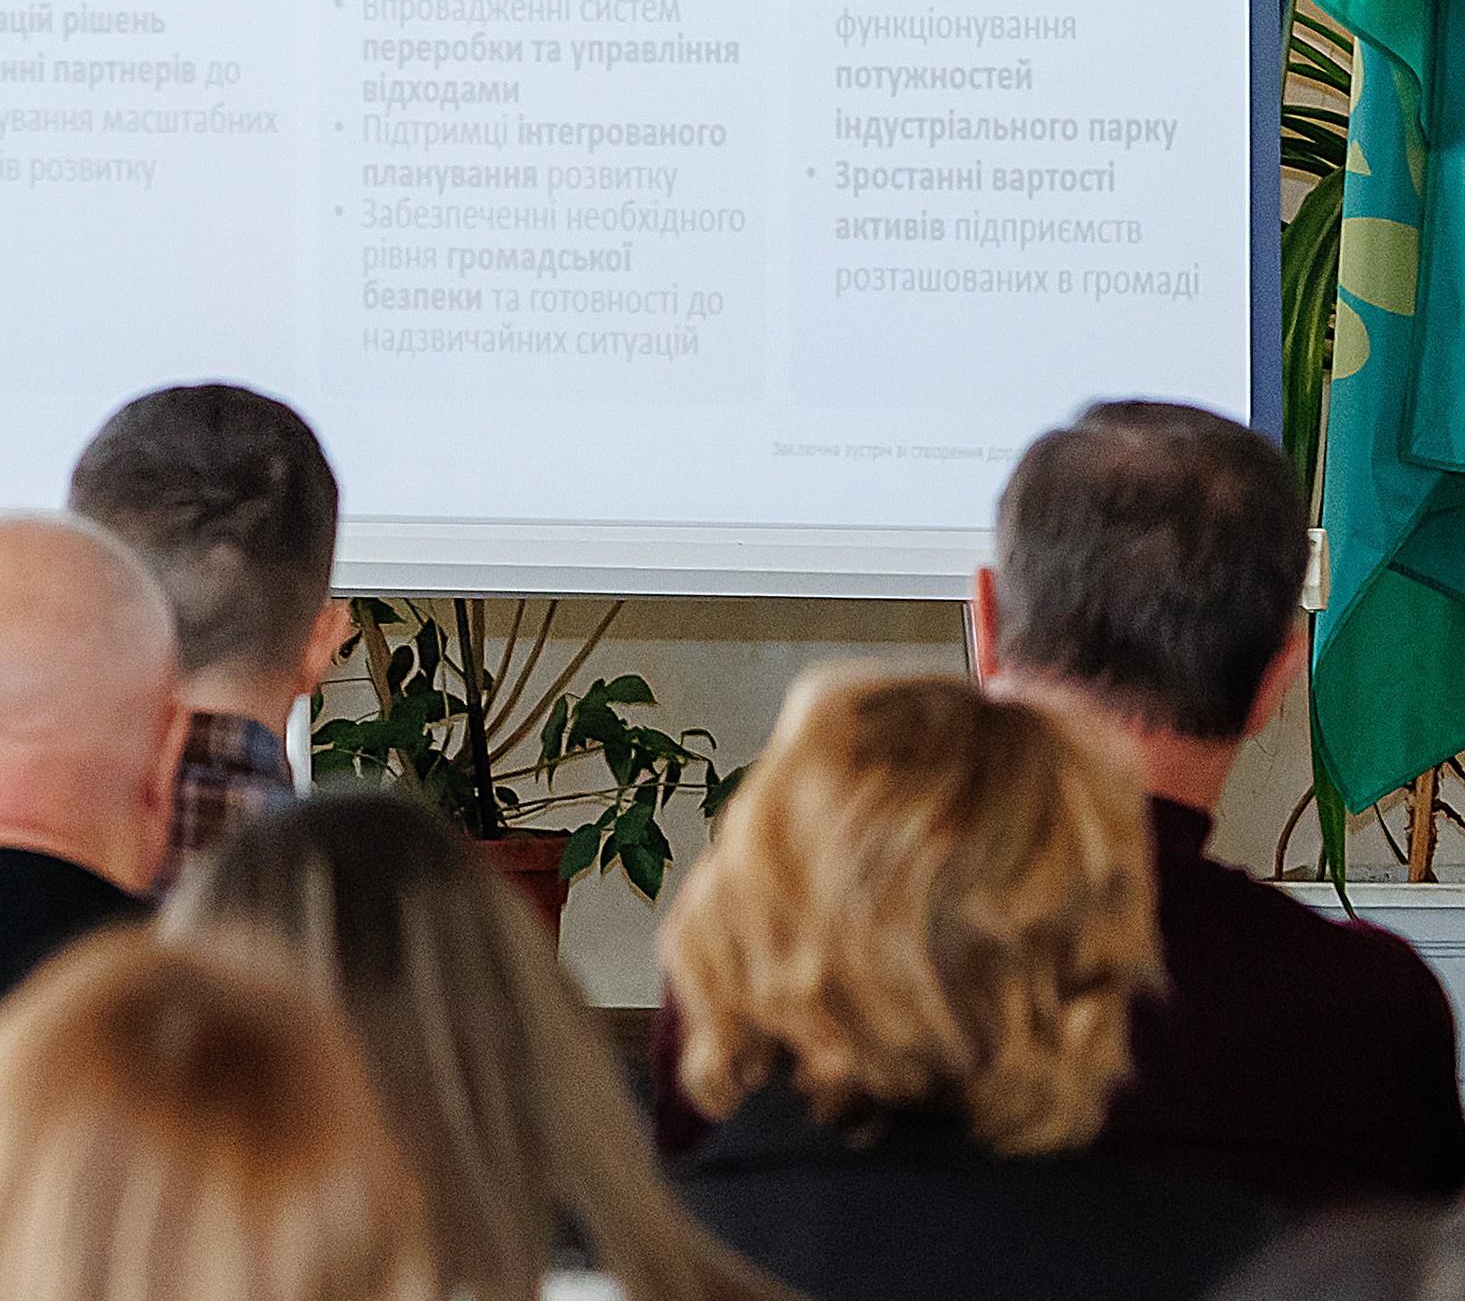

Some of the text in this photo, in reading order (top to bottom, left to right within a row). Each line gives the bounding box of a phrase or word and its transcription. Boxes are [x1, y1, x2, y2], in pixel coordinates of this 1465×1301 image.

[63, 4, 166, 39] рішень
[835, 7, 1076, 47] функціонування
[362, 32, 740, 70] переробки та управління
[54, 52, 196, 90] партнерів
[205, 60, 241, 88] до
[835, 59, 1032, 98] потужностей
[362, 72, 519, 111] відходами
[102, 102, 278, 134] масштабних
[362, 114, 727, 152] Підтримці інтегрованого
[835, 108, 1178, 150] індустріального парку
[30, 158, 157, 189] розвитку
[362, 164, 678, 197] планування розвитку
[835, 160, 1115, 199] Зростанні вартості
[362, 198, 746, 236] Забезпеченні необхідного
[835, 210, 1142, 250] активів підприємств
[362, 238, 633, 278] рівня громадської
[362, 280, 723, 319] безпеки та готовності до
[835, 263, 1200, 302] розташованих в громаді
[362, 322, 698, 362] надзвичайних ситуацій
